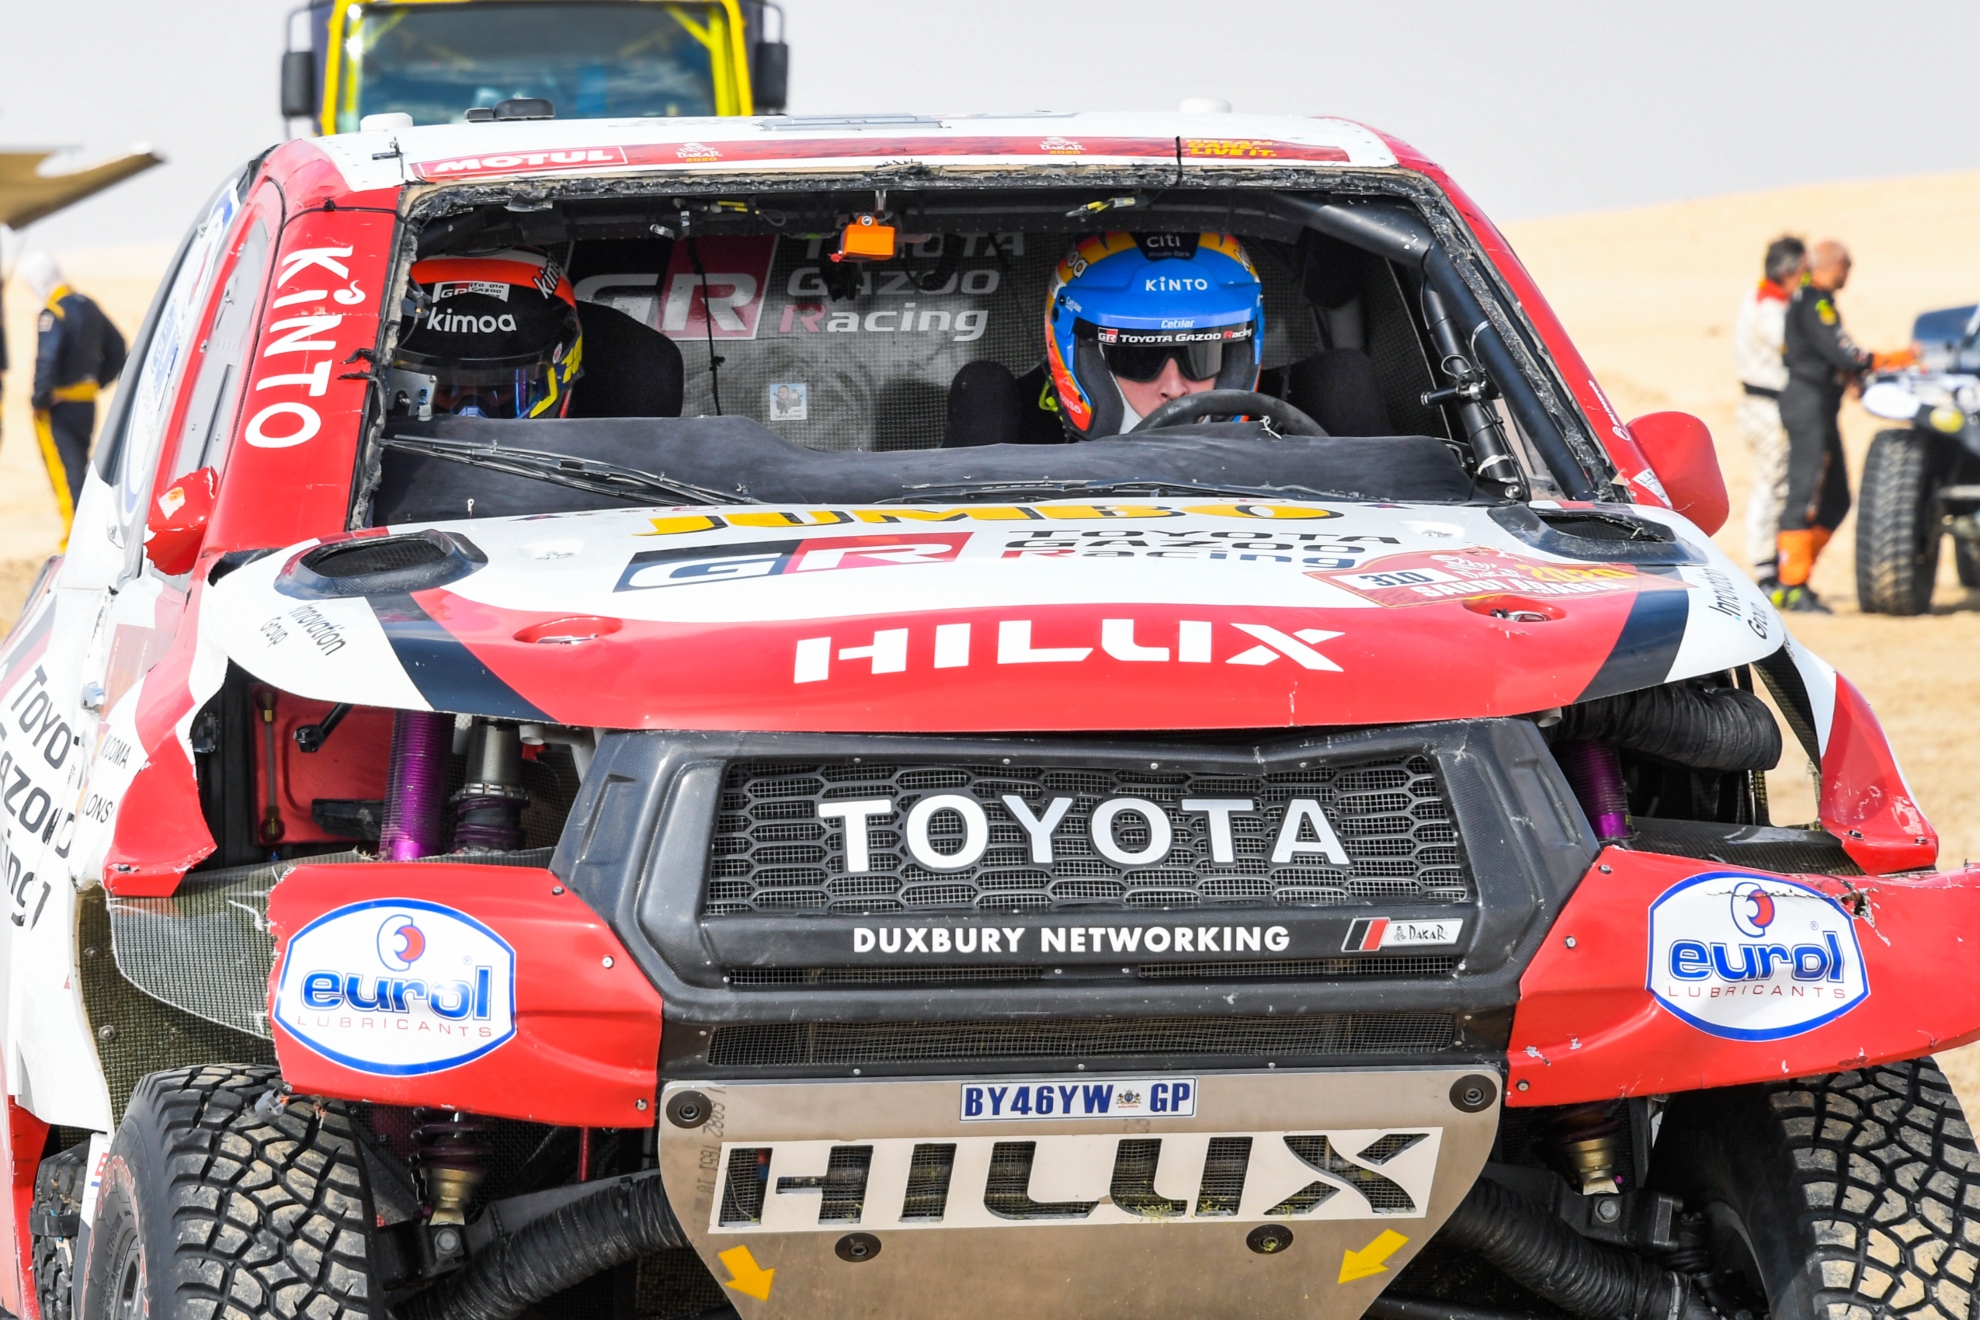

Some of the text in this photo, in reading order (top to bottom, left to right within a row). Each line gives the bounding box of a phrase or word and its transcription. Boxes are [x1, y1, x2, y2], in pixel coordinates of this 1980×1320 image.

[434, 150, 614, 172] MOTUL
[1190, 147, 1278, 157] LIVE IT.
[427, 307, 517, 333] kimoa
[780, 303, 988, 342] Racing
[1099, 332, 1117, 343] GR
[1120, 334, 1172, 343] TOYOTA
[1175, 333, 1221, 341] GAZOO
[631, 504, 1344, 536] JUMBO
[1005, 539, 1365, 553] GAZOO
[1008, 530, 1401, 544] TOYOTA
[627, 543, 954, 588] GR
[1001, 549, 1356, 569] Racing
[1358, 570, 1436, 587] 310
[1409, 578, 1508, 597] SAUDI
[260, 616, 289, 648] Group
[288, 602, 347, 656] Innovation
[795, 619, 1345, 684] HILUX
[817, 794, 1351, 874] TOYOTA
[852, 926, 1290, 954] DUXBURY NETWORKING
[1668, 930, 1845, 983] eurol
[301, 965, 493, 1021] eurol
[1668, 984, 1846, 999] LUBRICANTS
[297, 1015, 492, 1038] LUBRICANTS
[964, 1082, 1191, 1117] BY46YW GP
[718, 1132, 1430, 1228] HILUX
